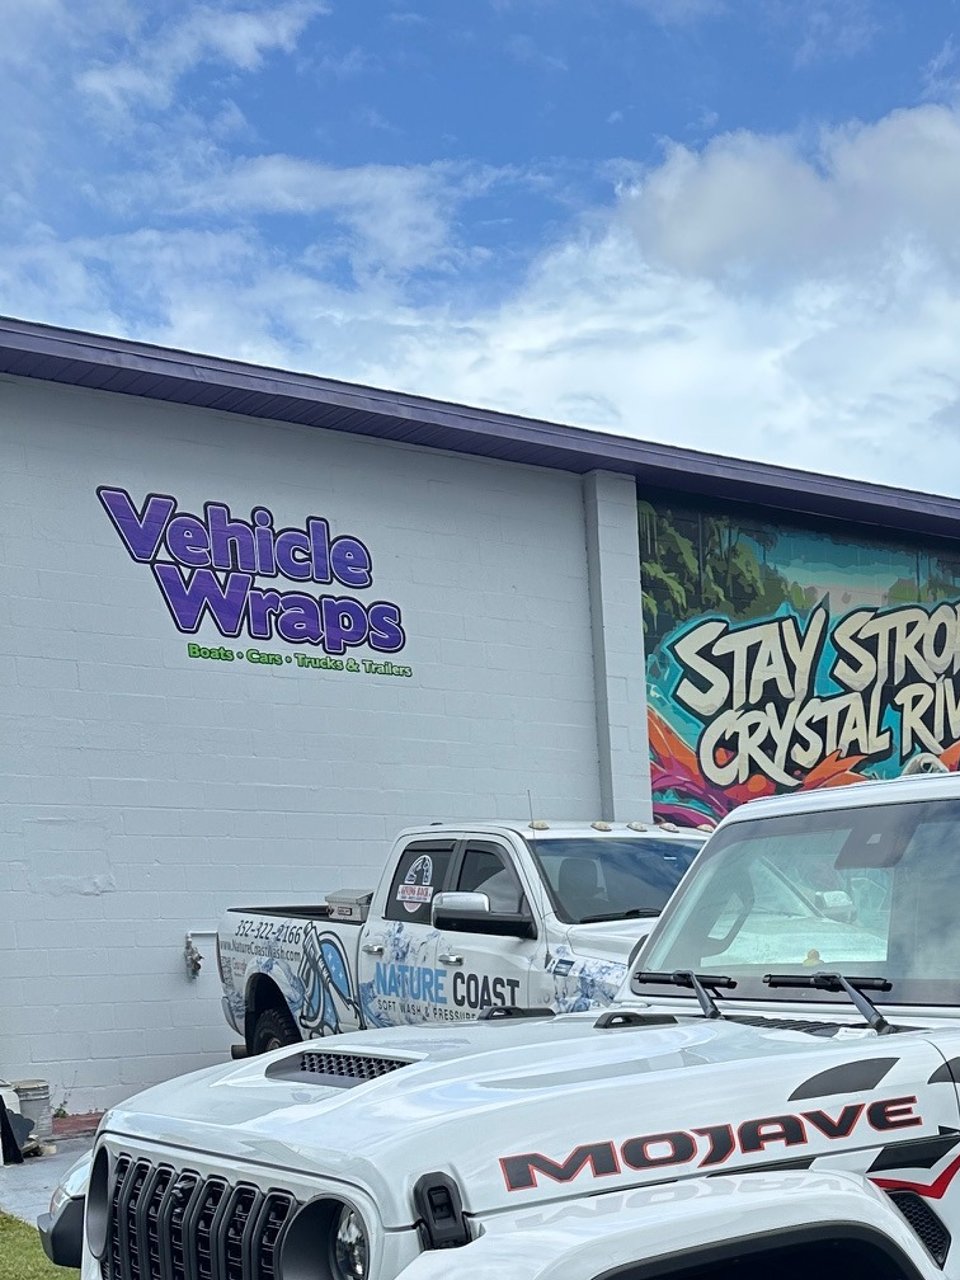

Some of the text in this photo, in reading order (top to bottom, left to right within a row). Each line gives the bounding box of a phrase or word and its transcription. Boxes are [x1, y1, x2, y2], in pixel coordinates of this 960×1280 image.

[96, 485, 372, 589] Vehicle
[152, 559, 406, 655] Wraps
[187, 643, 413, 678] Boats Cars Trucks & Trailers
[673, 605, 828, 716] STAY
[699, 685, 891, 787] CRYSTAL
[234, 919, 303, 945] 352-322-2166
[375, 961, 520, 1010] NATURE COAST
[377, 999, 397, 1013] SOFT
[399, 1003, 422, 1016] WASH
[499, 1095, 923, 1193] MOJAVE
